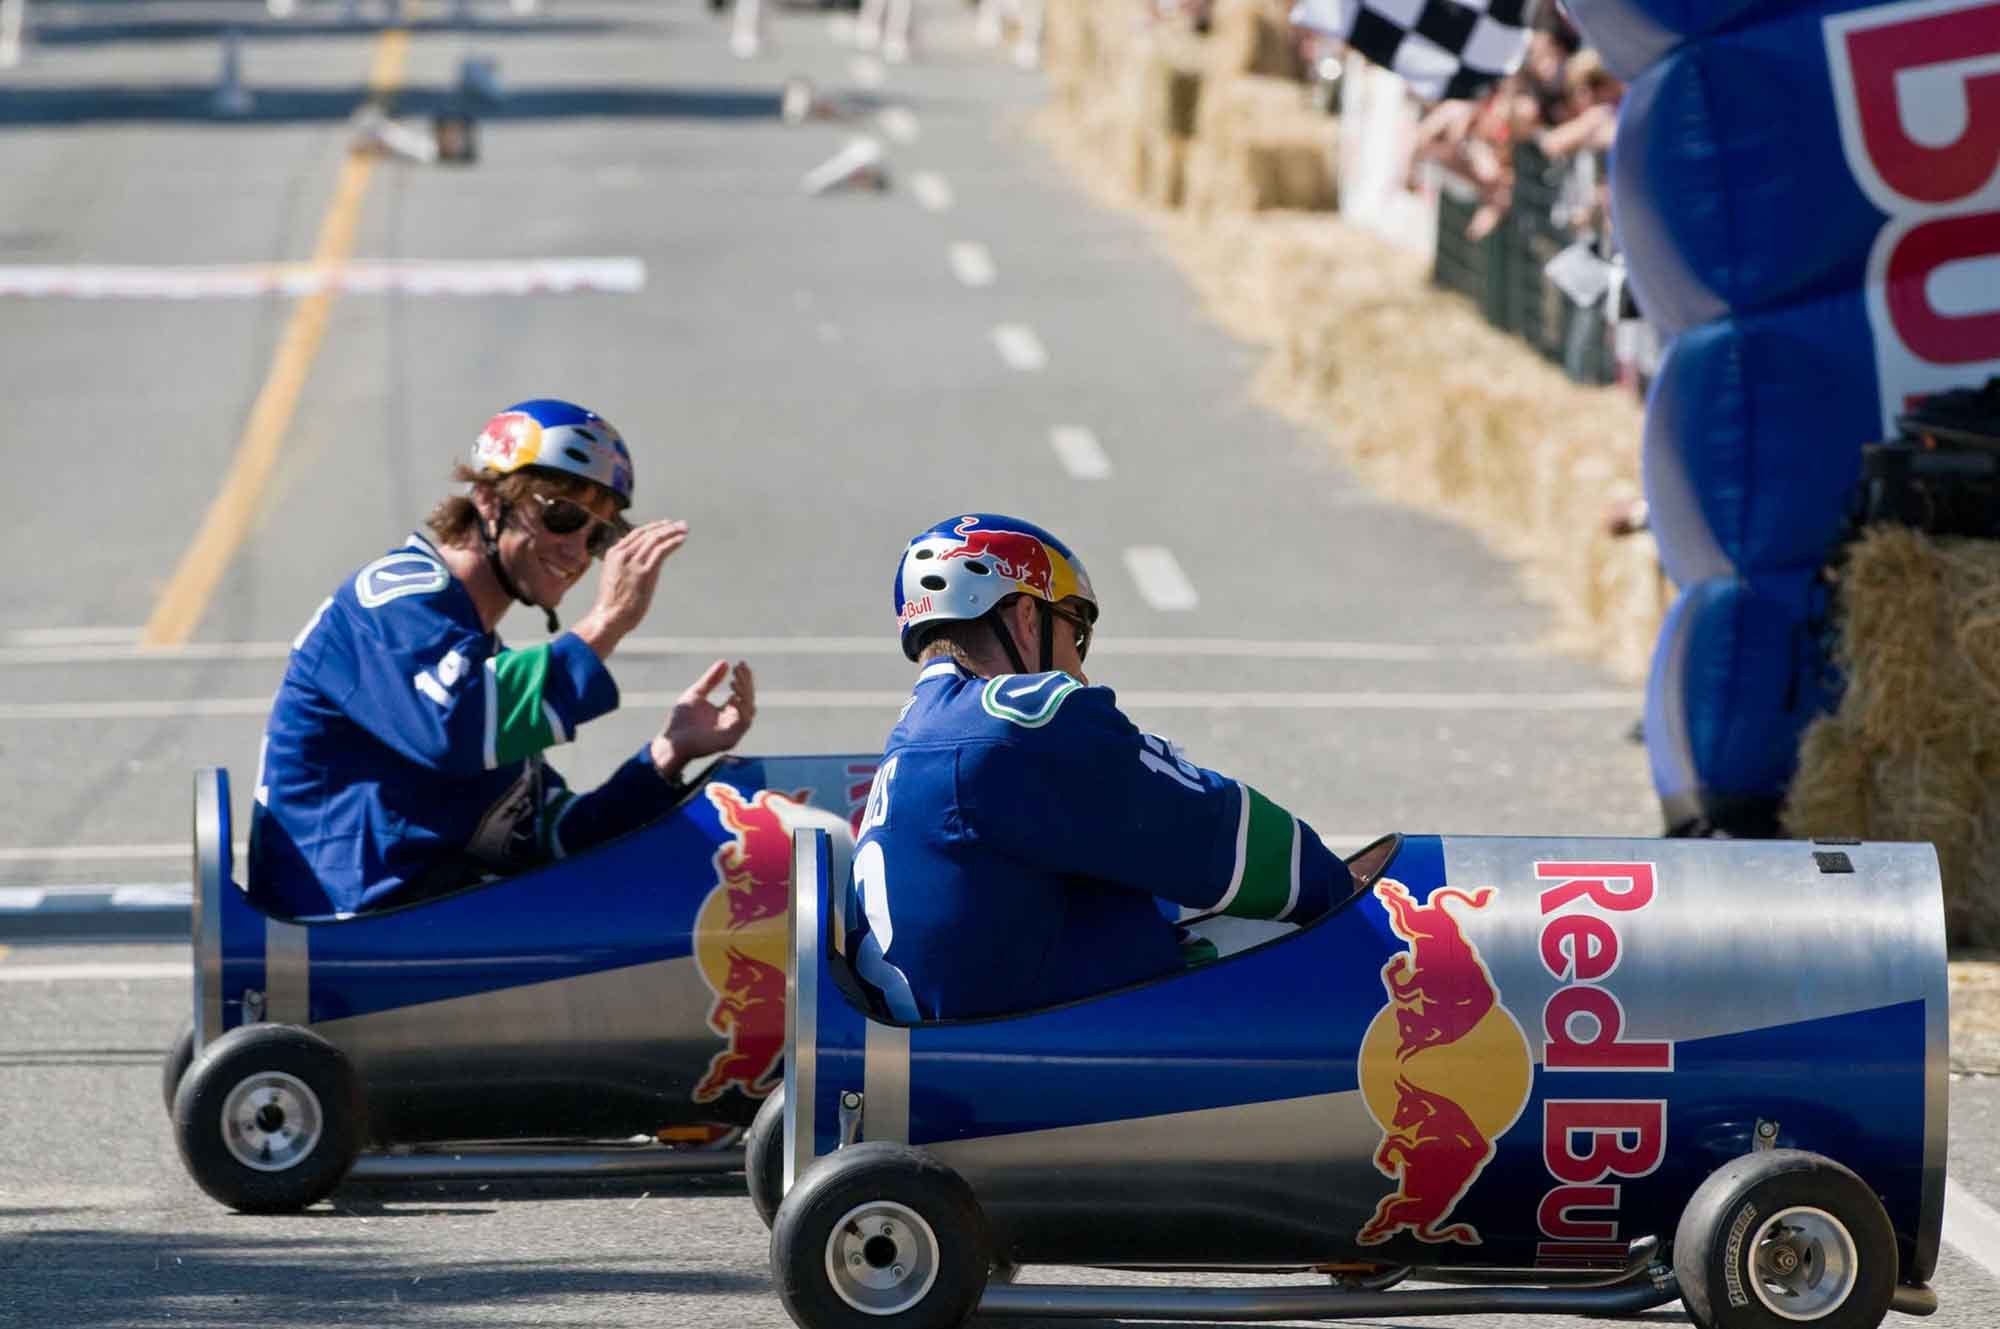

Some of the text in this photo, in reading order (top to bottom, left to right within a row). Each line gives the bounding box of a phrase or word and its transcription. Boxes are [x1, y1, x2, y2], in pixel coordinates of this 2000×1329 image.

[906, 596, 933, 619] Bull
[1534, 862, 1675, 1072] Red
[1725, 1201, 1758, 1307] BRIDGESTONE
